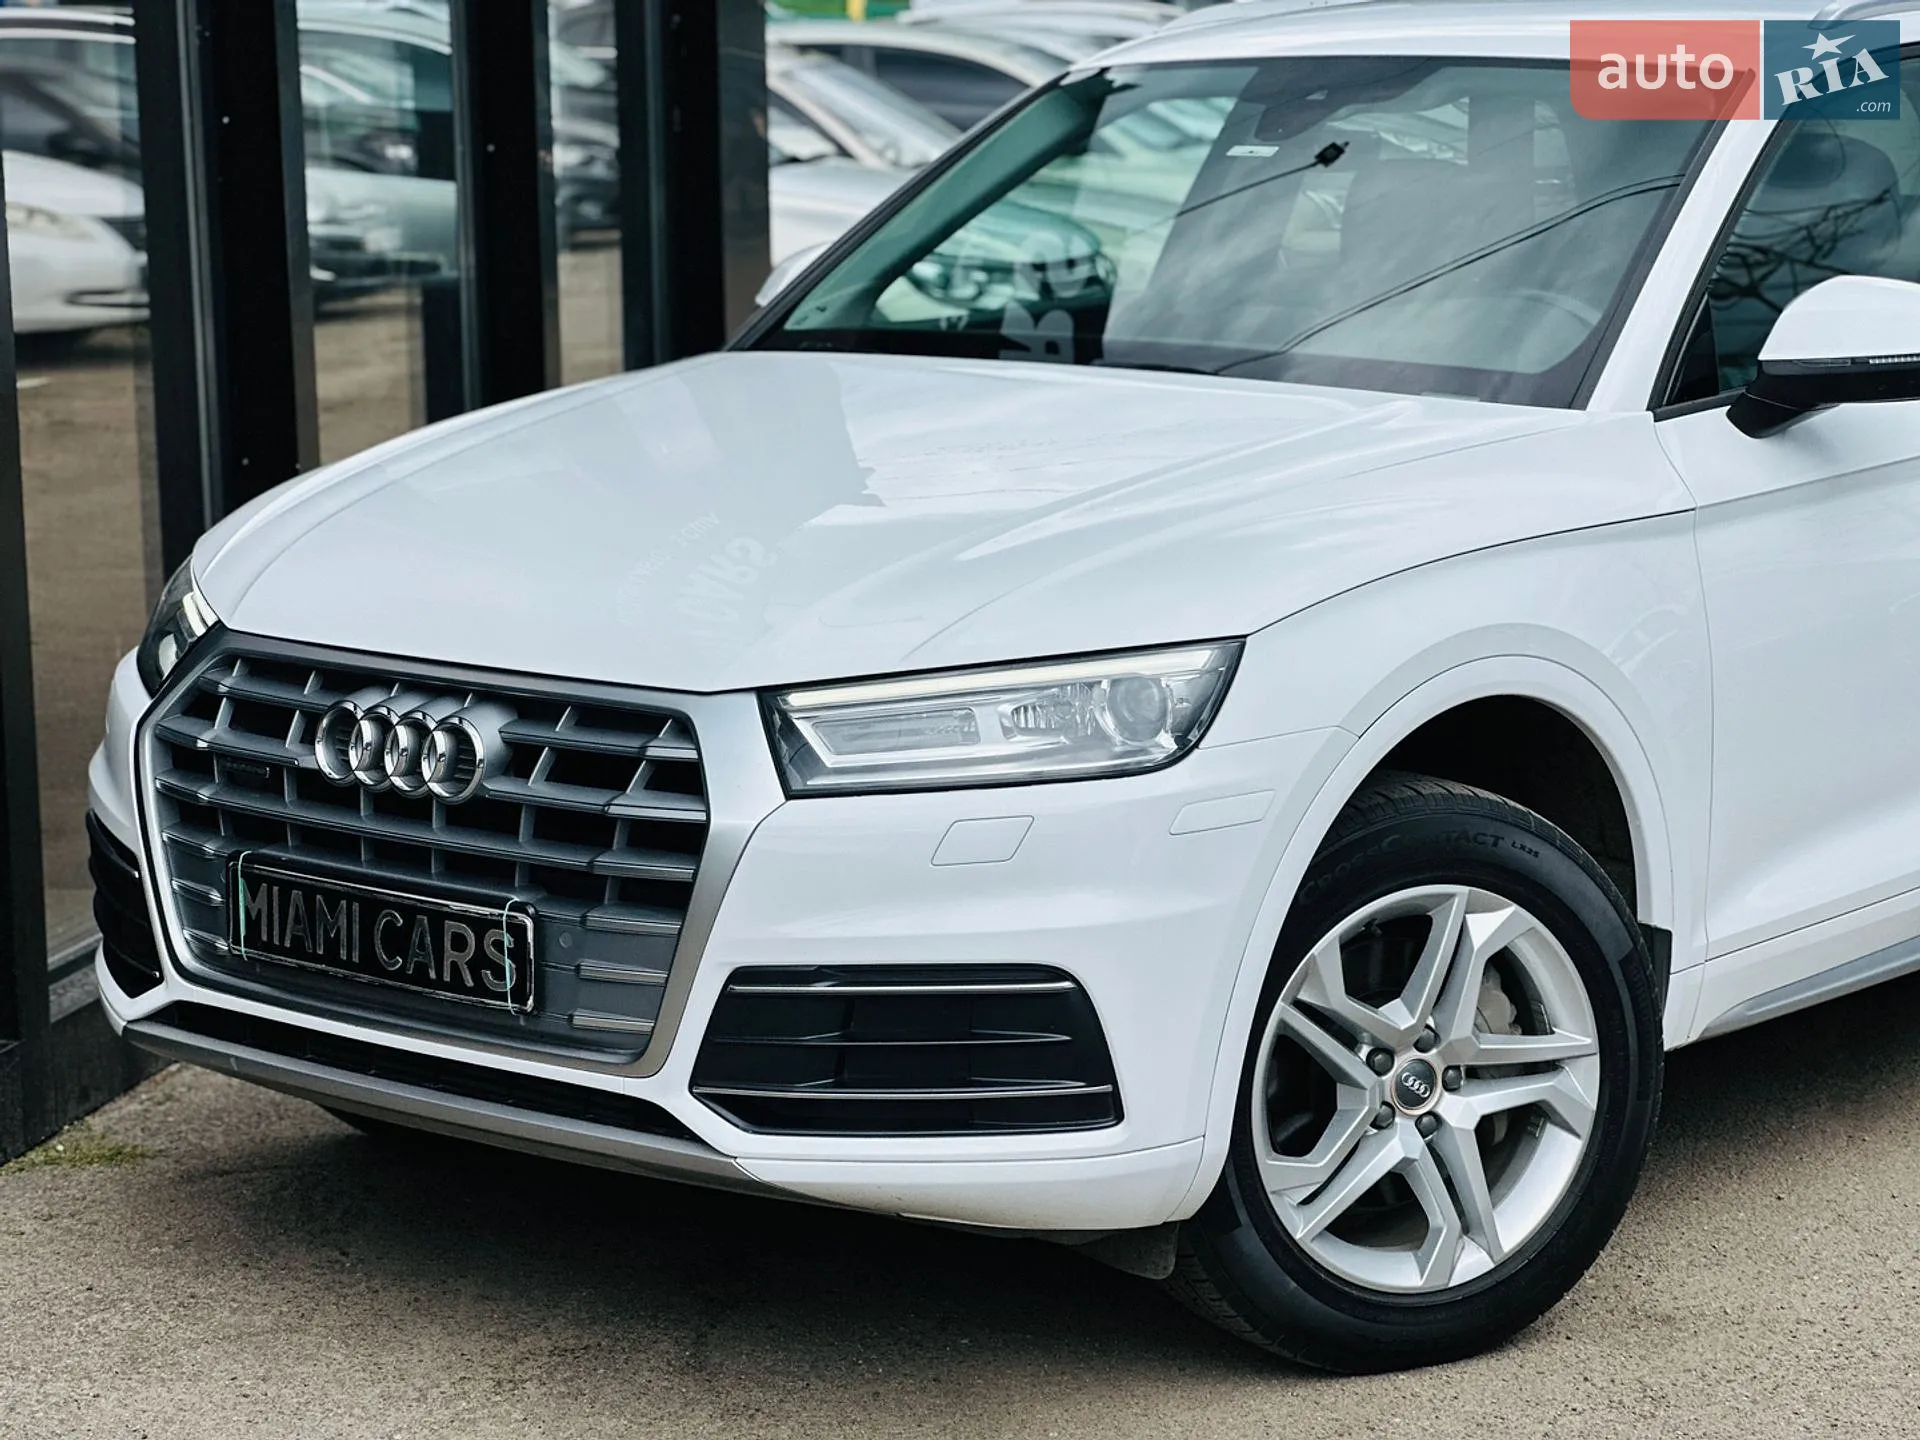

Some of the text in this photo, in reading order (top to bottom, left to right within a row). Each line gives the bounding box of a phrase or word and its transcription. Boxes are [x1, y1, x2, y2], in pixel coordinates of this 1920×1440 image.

[1299, 828, 1504, 905] CROSSCTACT
[240, 878, 517, 992] MIAMI CARS
